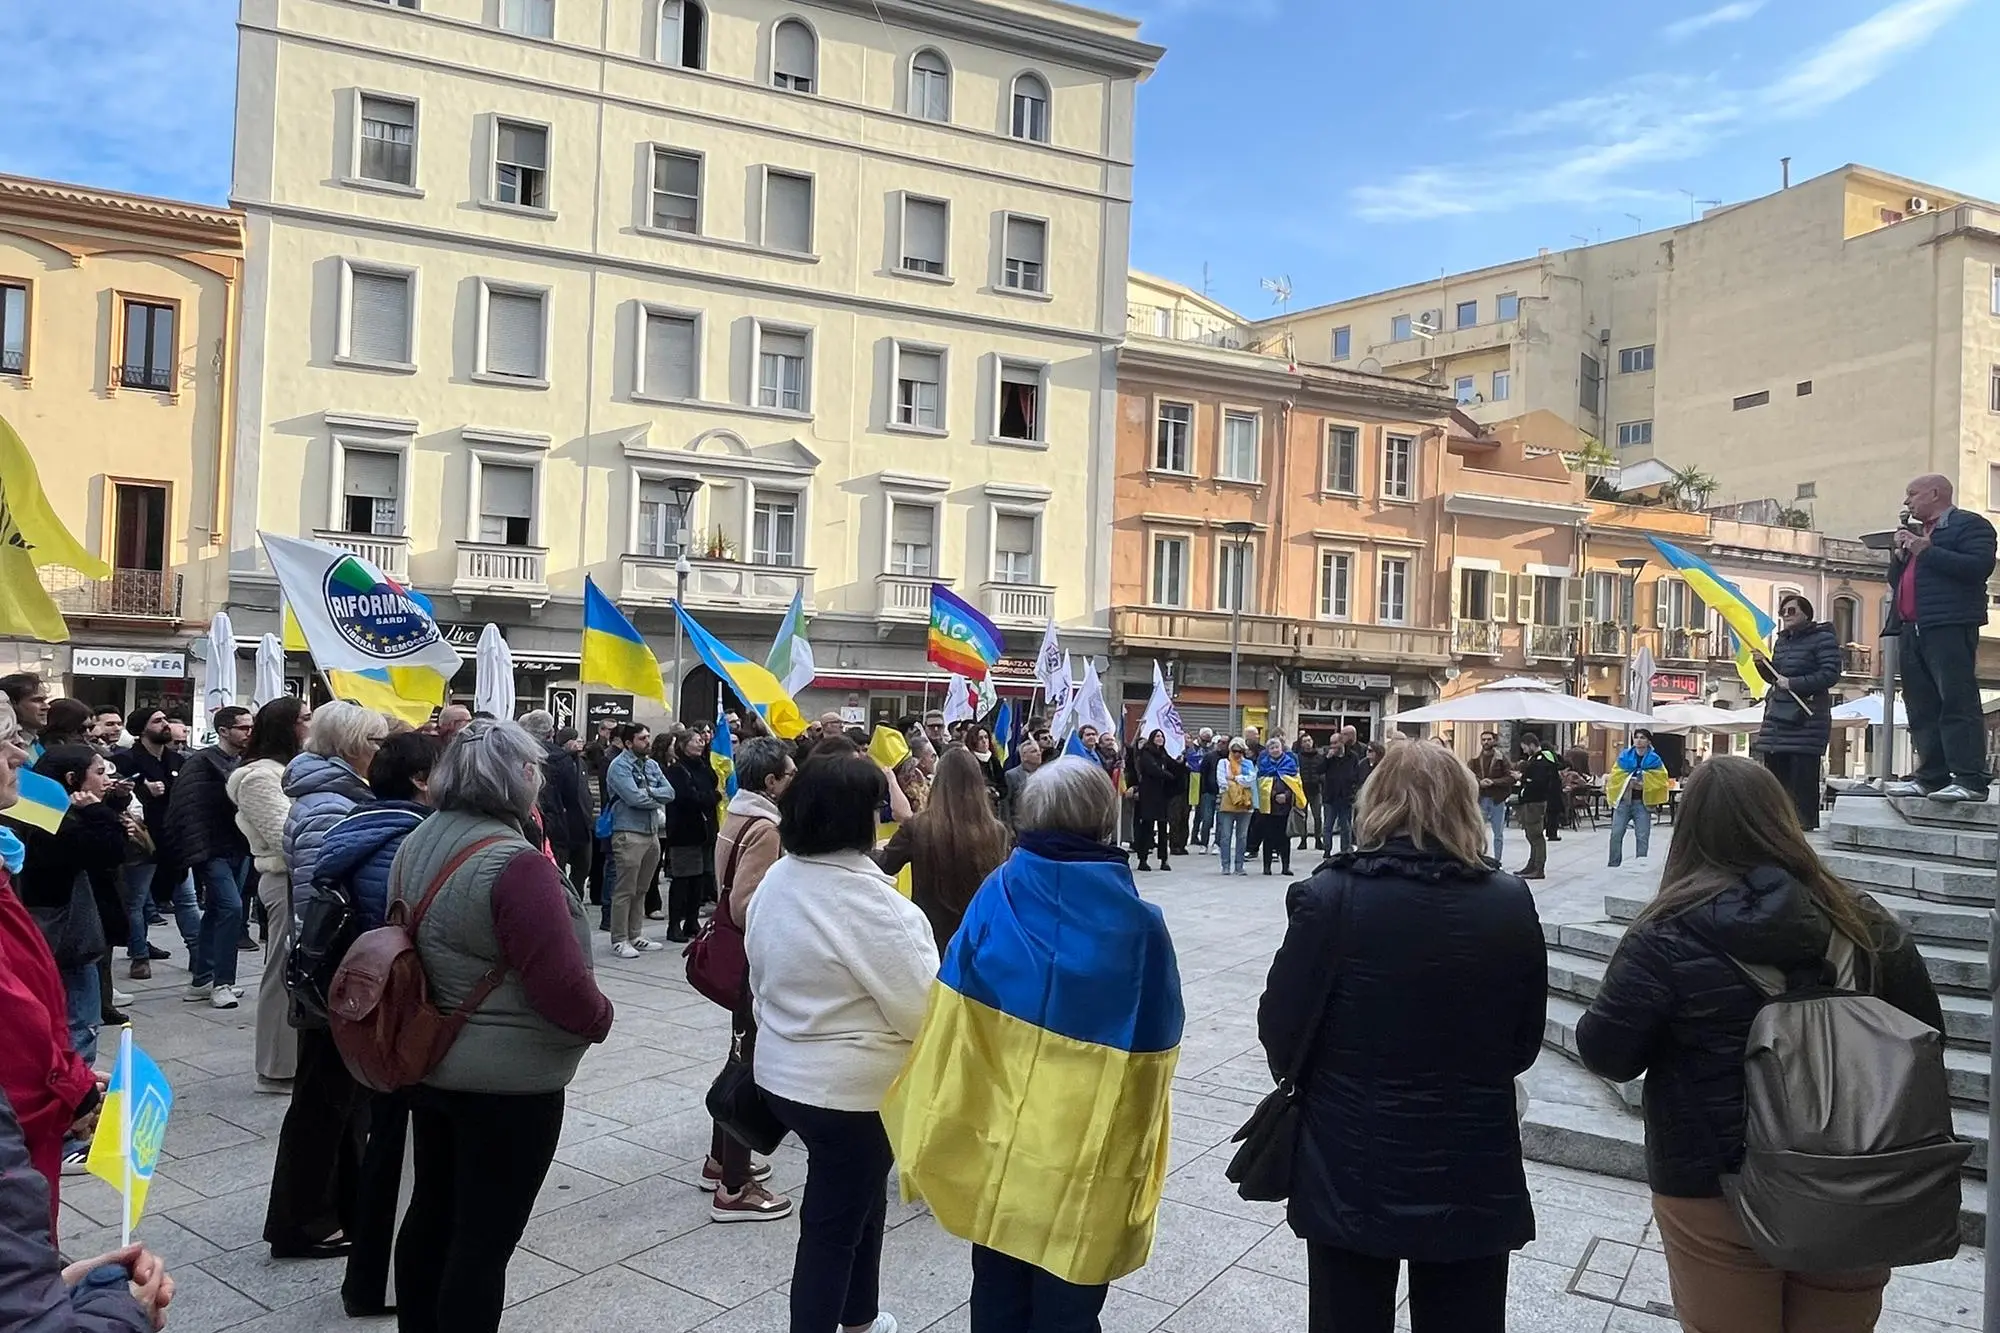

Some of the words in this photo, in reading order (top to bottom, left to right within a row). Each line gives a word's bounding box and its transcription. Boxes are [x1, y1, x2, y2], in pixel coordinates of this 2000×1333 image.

[331, 593, 432, 621] RIFORMATO
[375, 617, 407, 625] SARDI
[342, 623, 378, 652] LIBERAL
[384, 630, 436, 653] DEMOCRA
[445, 624, 476, 641] Live
[76, 656, 125, 667] MOMO
[150, 659, 182, 670] TEA
[555, 696, 573, 730] Lina
